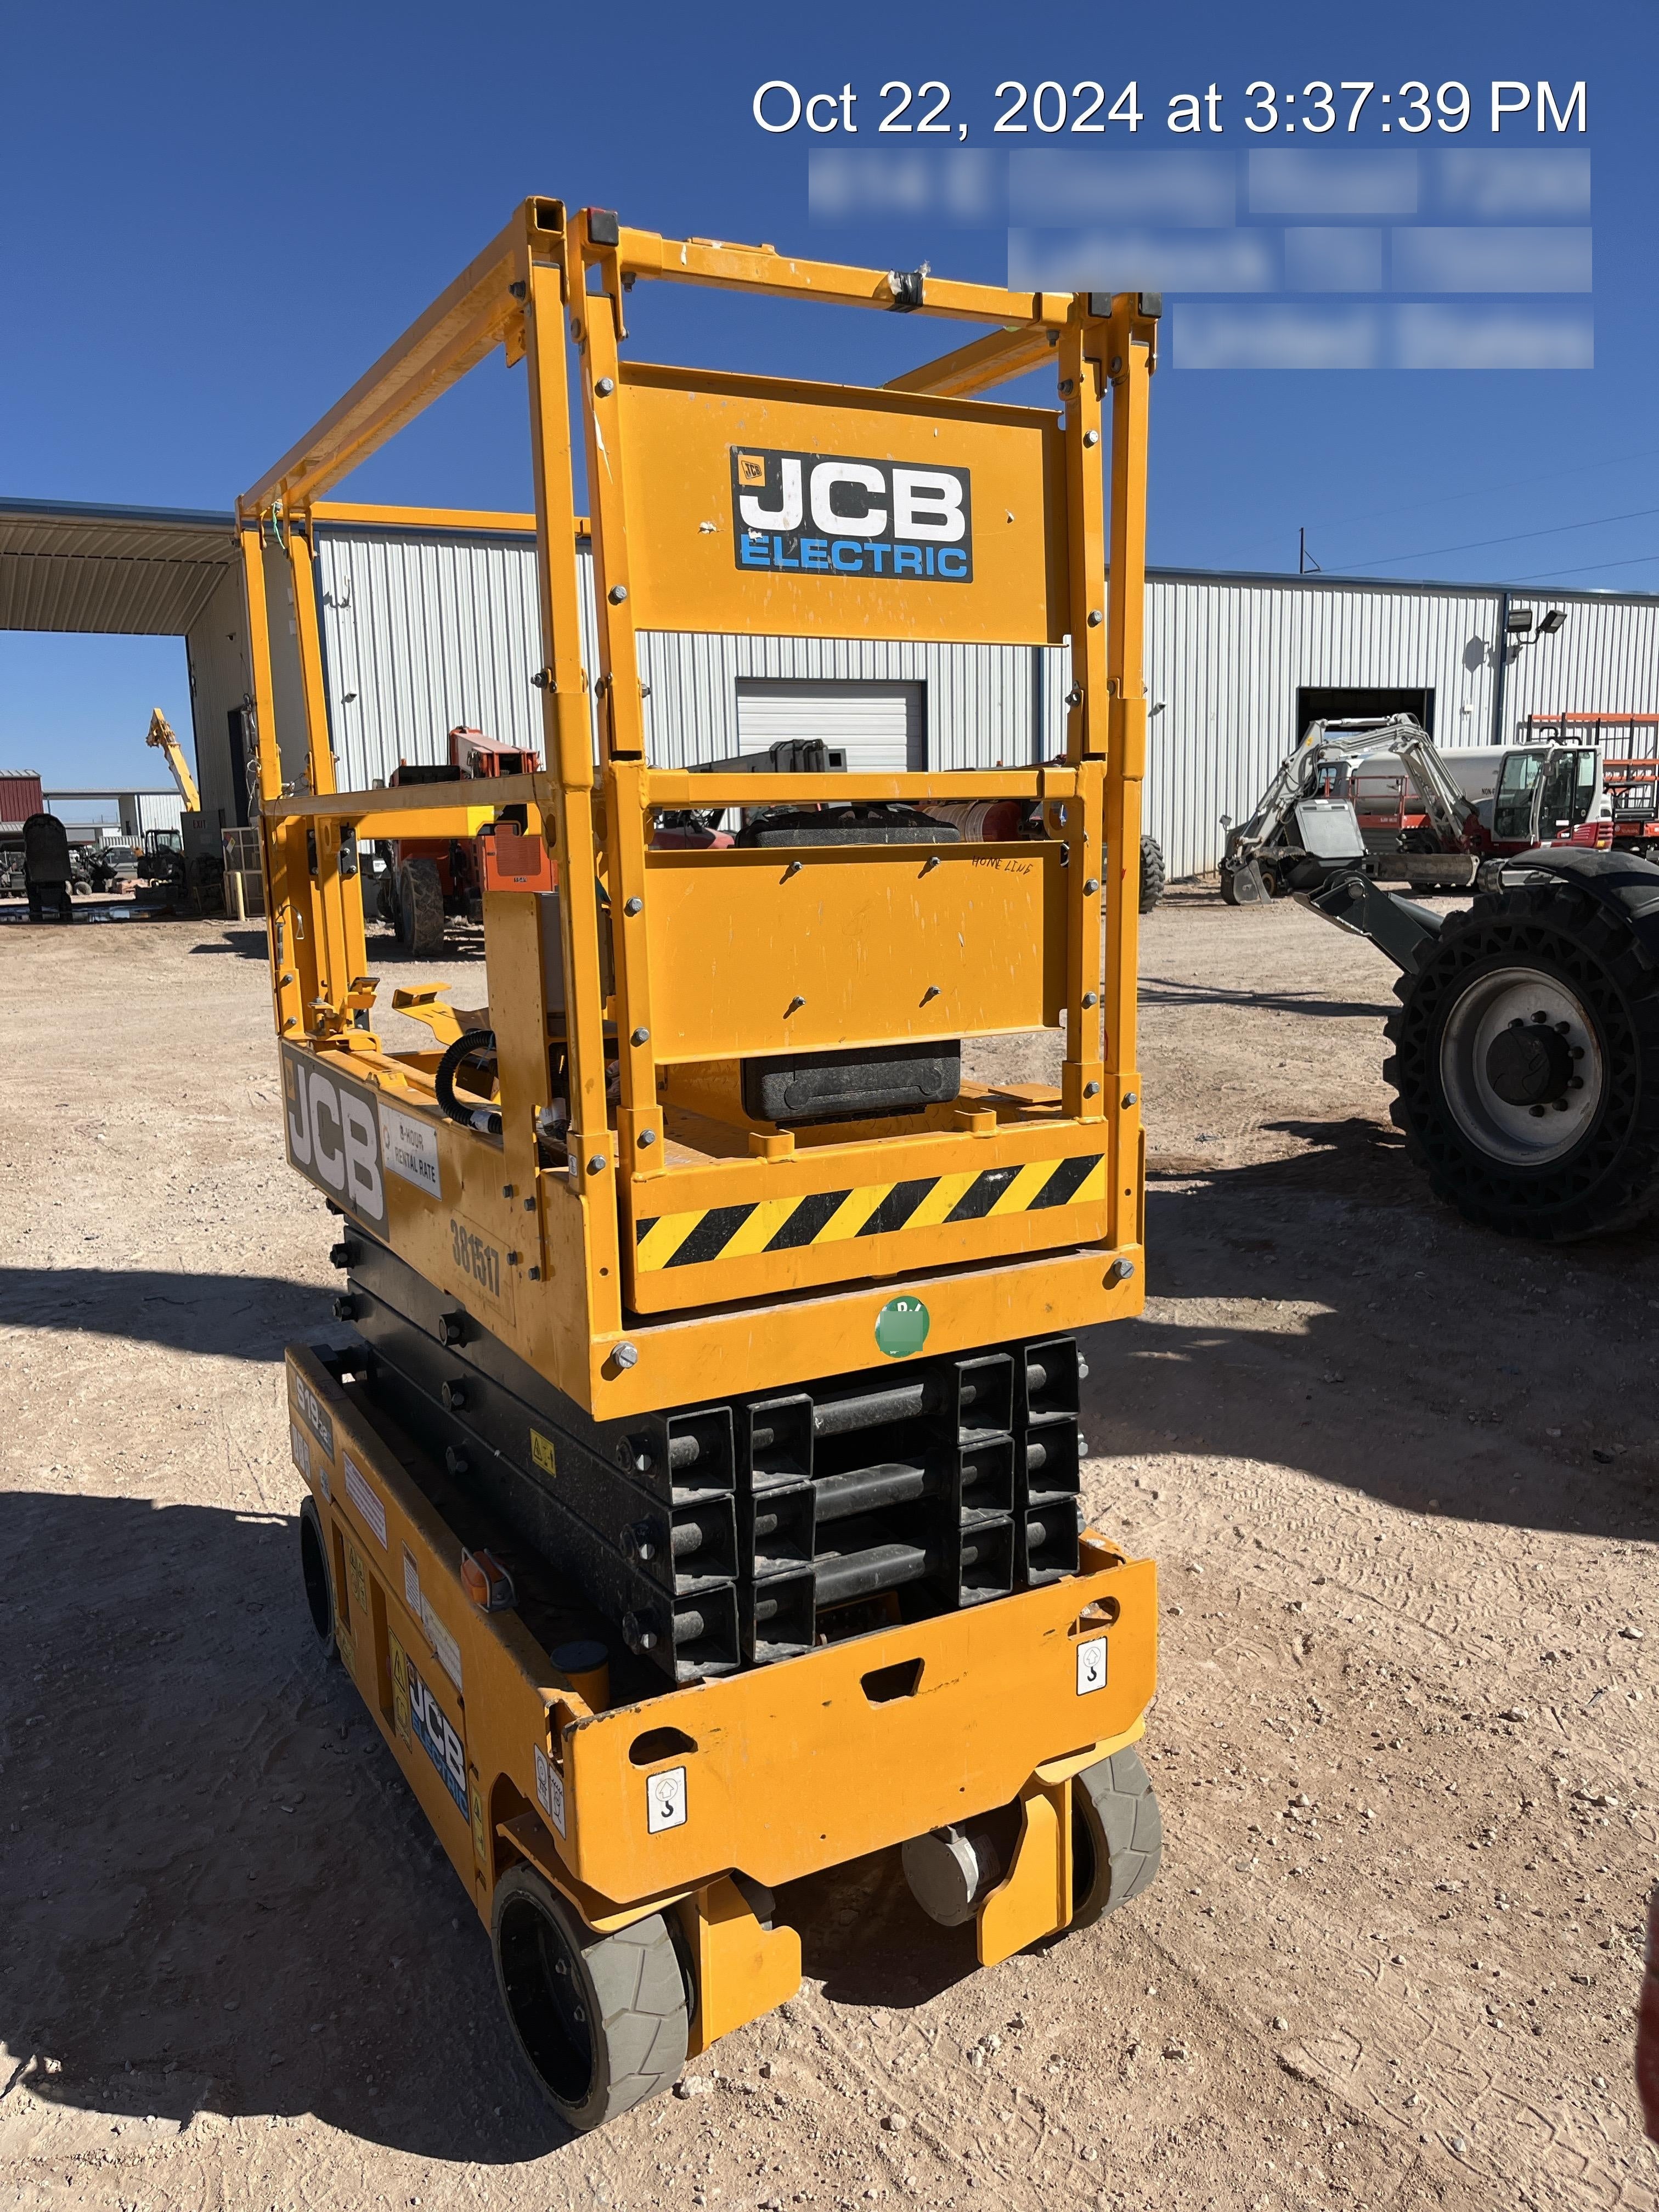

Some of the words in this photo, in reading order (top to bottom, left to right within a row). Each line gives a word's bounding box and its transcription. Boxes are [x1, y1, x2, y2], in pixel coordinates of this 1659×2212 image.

[739, 458, 966, 542] JCB
[745, 462, 760, 477] JCB
[741, 534, 967, 578] ELECTRIC
[193, 820, 206, 829] EXIT
[288, 1064, 383, 1221] JCB
[394, 1146, 418, 1173] RENTAL
[419, 1159, 436, 1183] RATE
[450, 1219, 500, 1297] 381517
[410, 1679, 466, 1792] JCB
[412, 1711, 470, 1824] ELECTRIC
